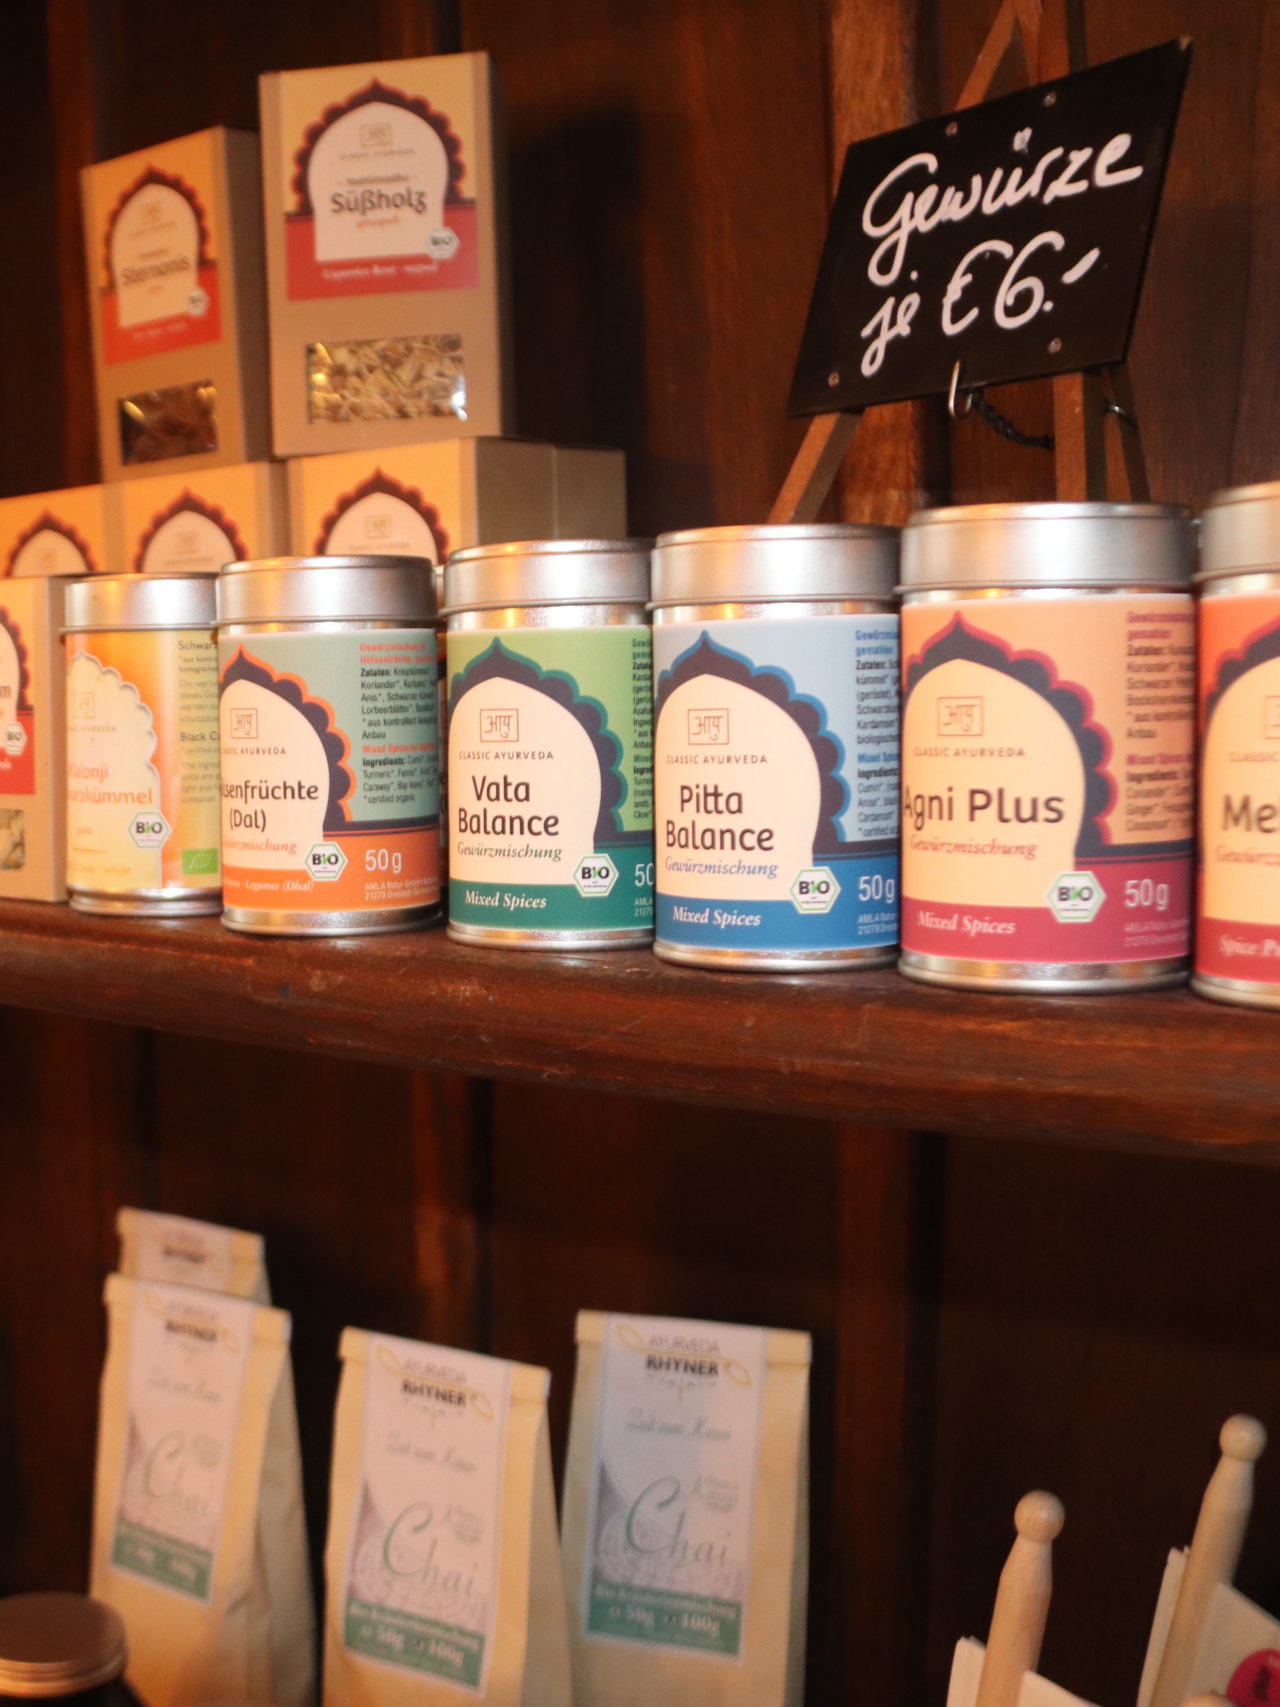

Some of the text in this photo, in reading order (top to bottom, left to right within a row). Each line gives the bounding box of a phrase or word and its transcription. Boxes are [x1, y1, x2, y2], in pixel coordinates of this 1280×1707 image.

[331, 188, 428, 214] Süßholz
[862, 126, 1143, 287] Gewürze
[860, 269, 921, 377] je
[180, 732, 206, 741] Black
[362, 731, 386, 739] Anbau
[240, 747, 286, 755] AYURVEDA
[459, 751, 554, 760] CLASSIC AYURVEDA
[667, 754, 768, 764] CLASSIC AYURVEDA
[914, 747, 1025, 757] CLASSIC AYURVEDA
[472, 774, 530, 802] Vata
[680, 783, 743, 815] Pitta
[904, 785, 1065, 831] Agni Plus
[1222, 794, 1280, 834] Me
[135, 822, 163, 834] BIO
[230, 808, 267, 833] (Dal)
[459, 807, 559, 836] Balance
[666, 820, 774, 851] Balance
[910, 833, 1038, 860] Gewürzmischung
[312, 854, 339, 866] BIO
[457, 841, 562, 862] Gewürzmischung
[581, 866, 610, 880] BIO
[665, 856, 778, 880] Gewürzmischung
[799, 881, 830, 895] BIO
[1058, 886, 1093, 901] BIO
[465, 890, 547, 910] Mixed Spices
[673, 906, 761, 929] Mixed Spices
[918, 911, 1016, 936] Mixed Spices
[1221, 934, 1257, 957] Spice
[648, 1335, 719, 1352] AYURVEDA
[646, 1355, 719, 1376] RHYNER
[402, 1379, 466, 1406] RHYNER
[625, 1476, 728, 1568] Chai
[383, 1501, 475, 1598] Chai
